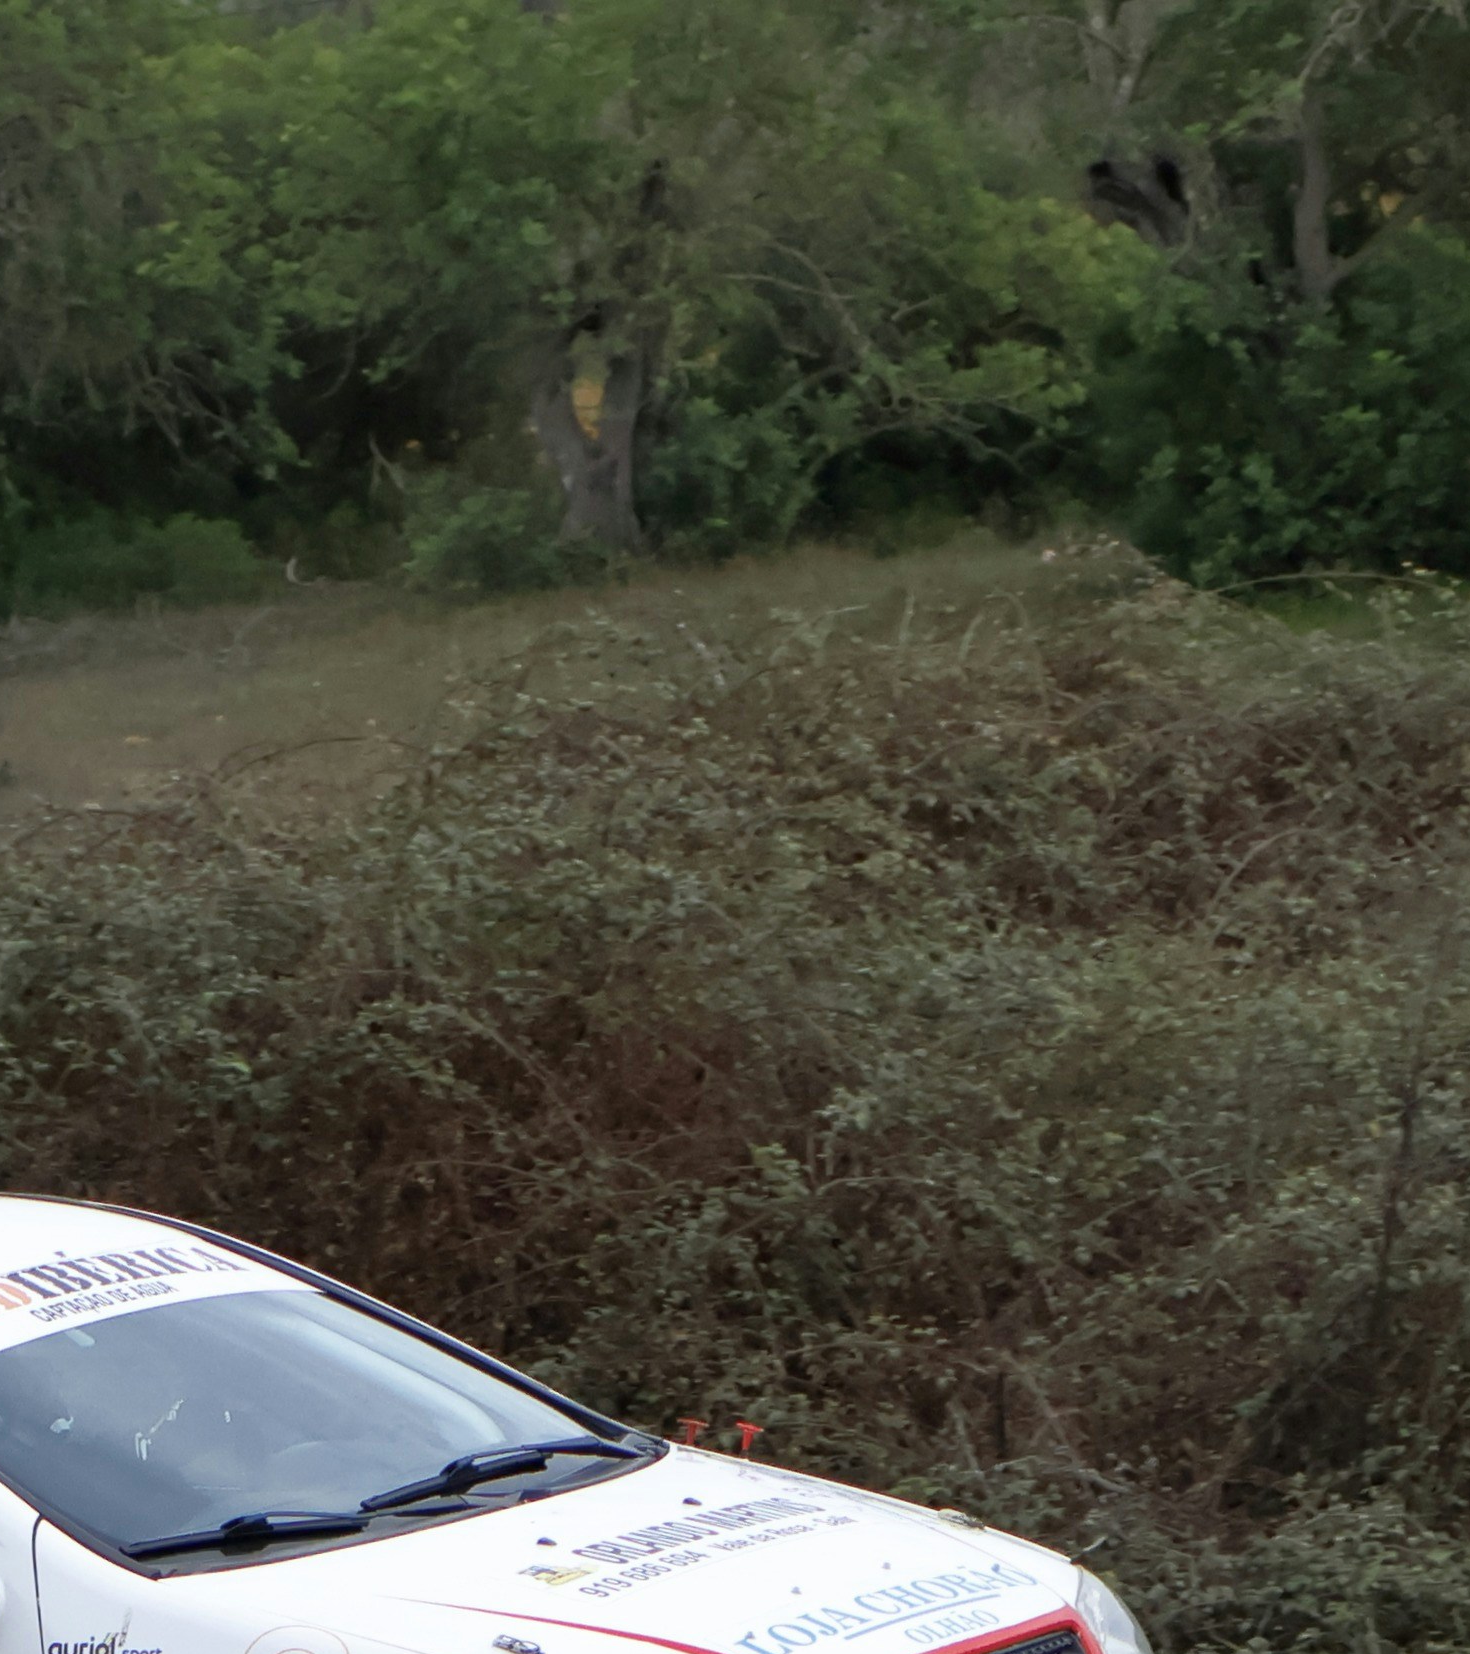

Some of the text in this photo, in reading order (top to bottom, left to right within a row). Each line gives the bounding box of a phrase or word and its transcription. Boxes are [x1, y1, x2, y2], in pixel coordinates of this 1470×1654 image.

[578, 1576, 633, 1598] 919
[853, 1563, 1039, 1617] CHORÃO
[904, 1608, 1000, 1644] OLHÃO
